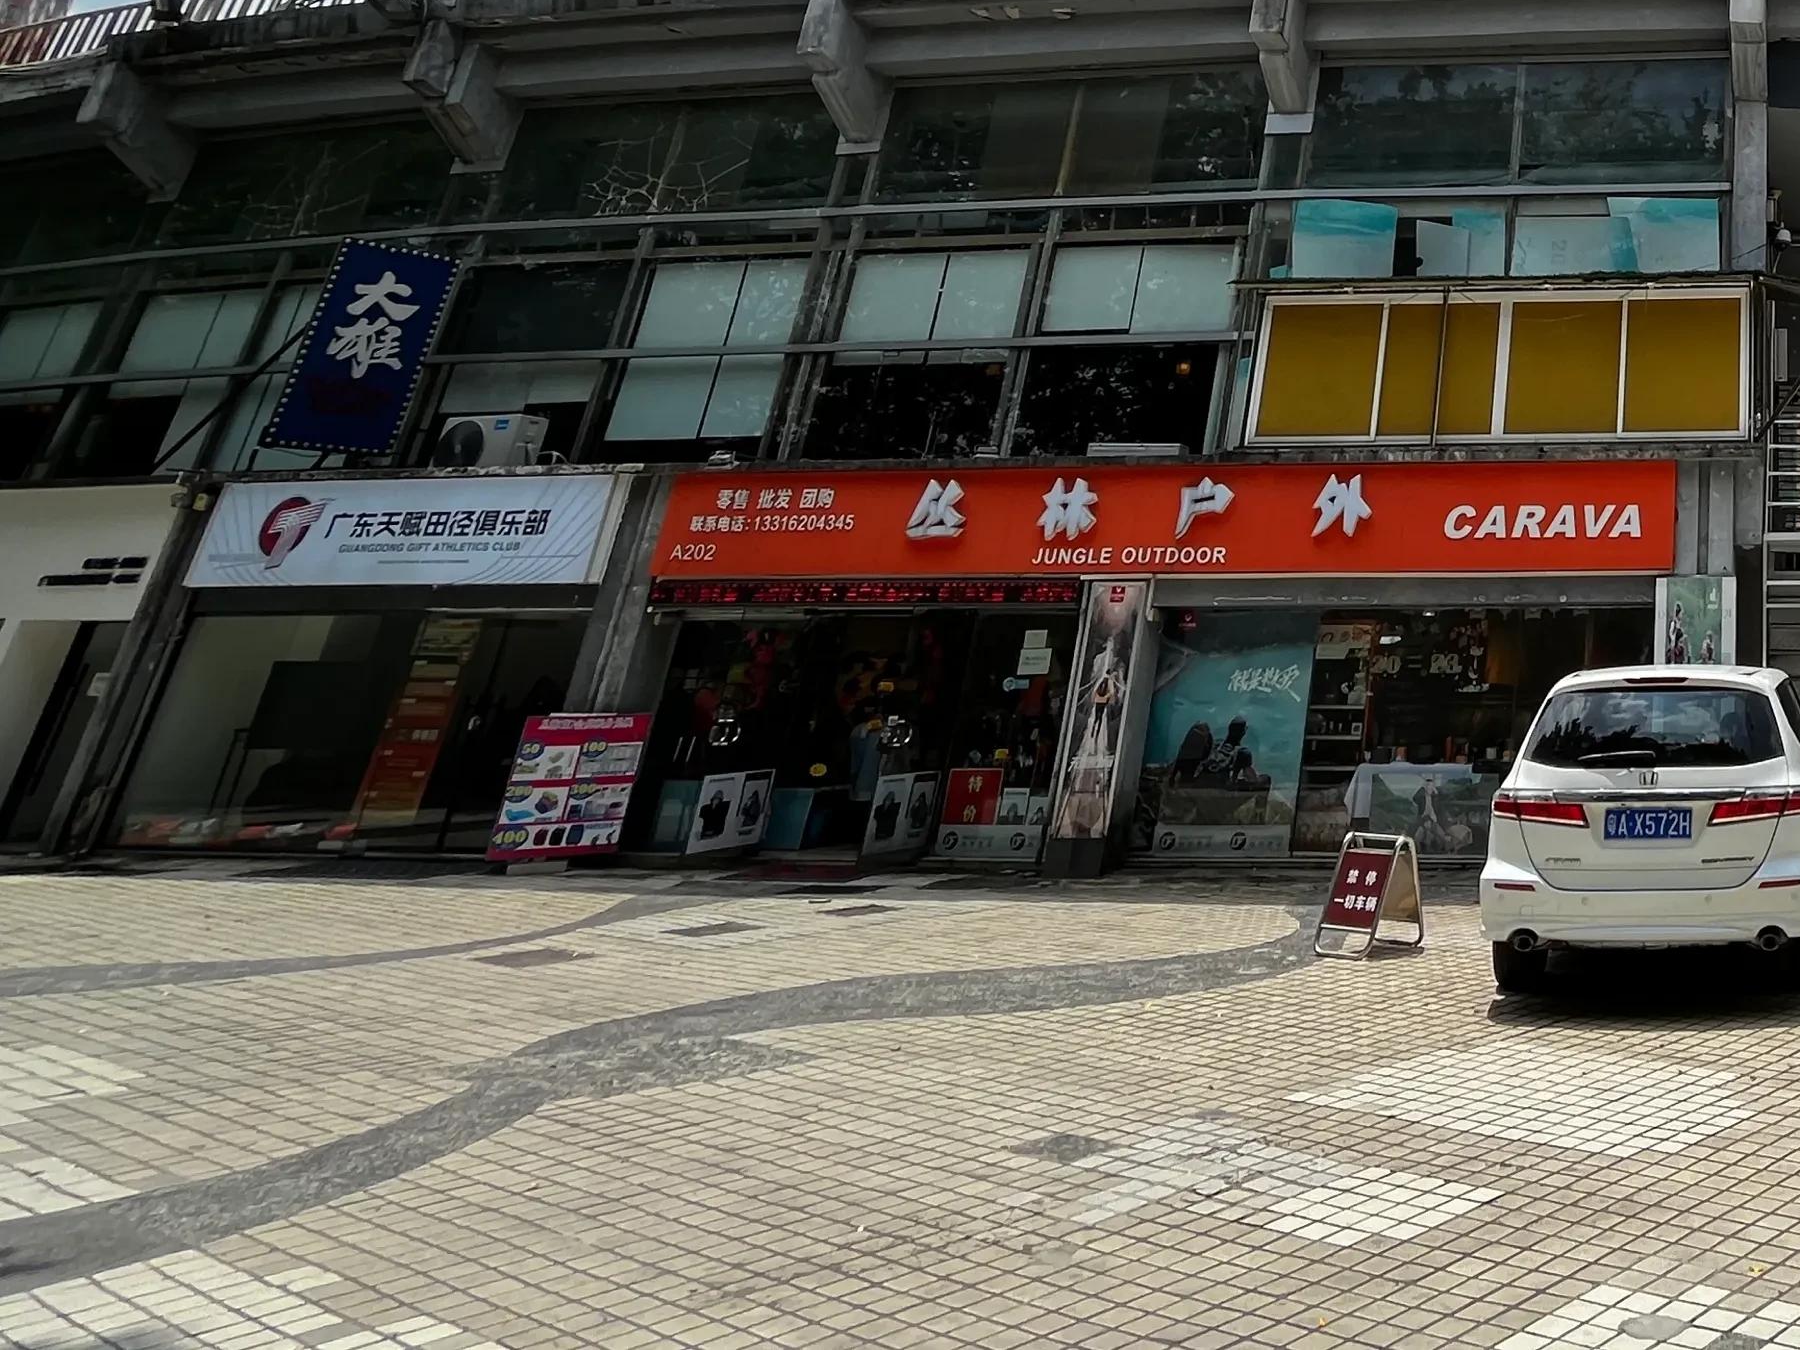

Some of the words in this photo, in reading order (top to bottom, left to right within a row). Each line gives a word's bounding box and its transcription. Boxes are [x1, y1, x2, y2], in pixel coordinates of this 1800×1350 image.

[326, 271, 421, 379] 大雄
[716, 489, 750, 509] 零售
[757, 488, 793, 509] 批发
[799, 488, 835, 509] 团购
[904, 472, 1373, 541] 丛林户外
[324, 509, 552, 538] 广东天赋田径俱乐部
[1443, 504, 1642, 539] CARAVA
[338, 543, 405, 553] GUANGDONG
[407, 542, 431, 552] GIFT
[432, 542, 490, 552] ATHLETICS
[492, 541, 521, 551] CLUB
[669, 544, 717, 561] A202
[1031, 547, 1113, 565] JUNGLE
[1121, 546, 1227, 564] OUTDOOR
[963, 774, 983, 823] 特价
[1346, 869, 1378, 886] 禁停
[1334, 894, 1378, 912] 一切车辆
